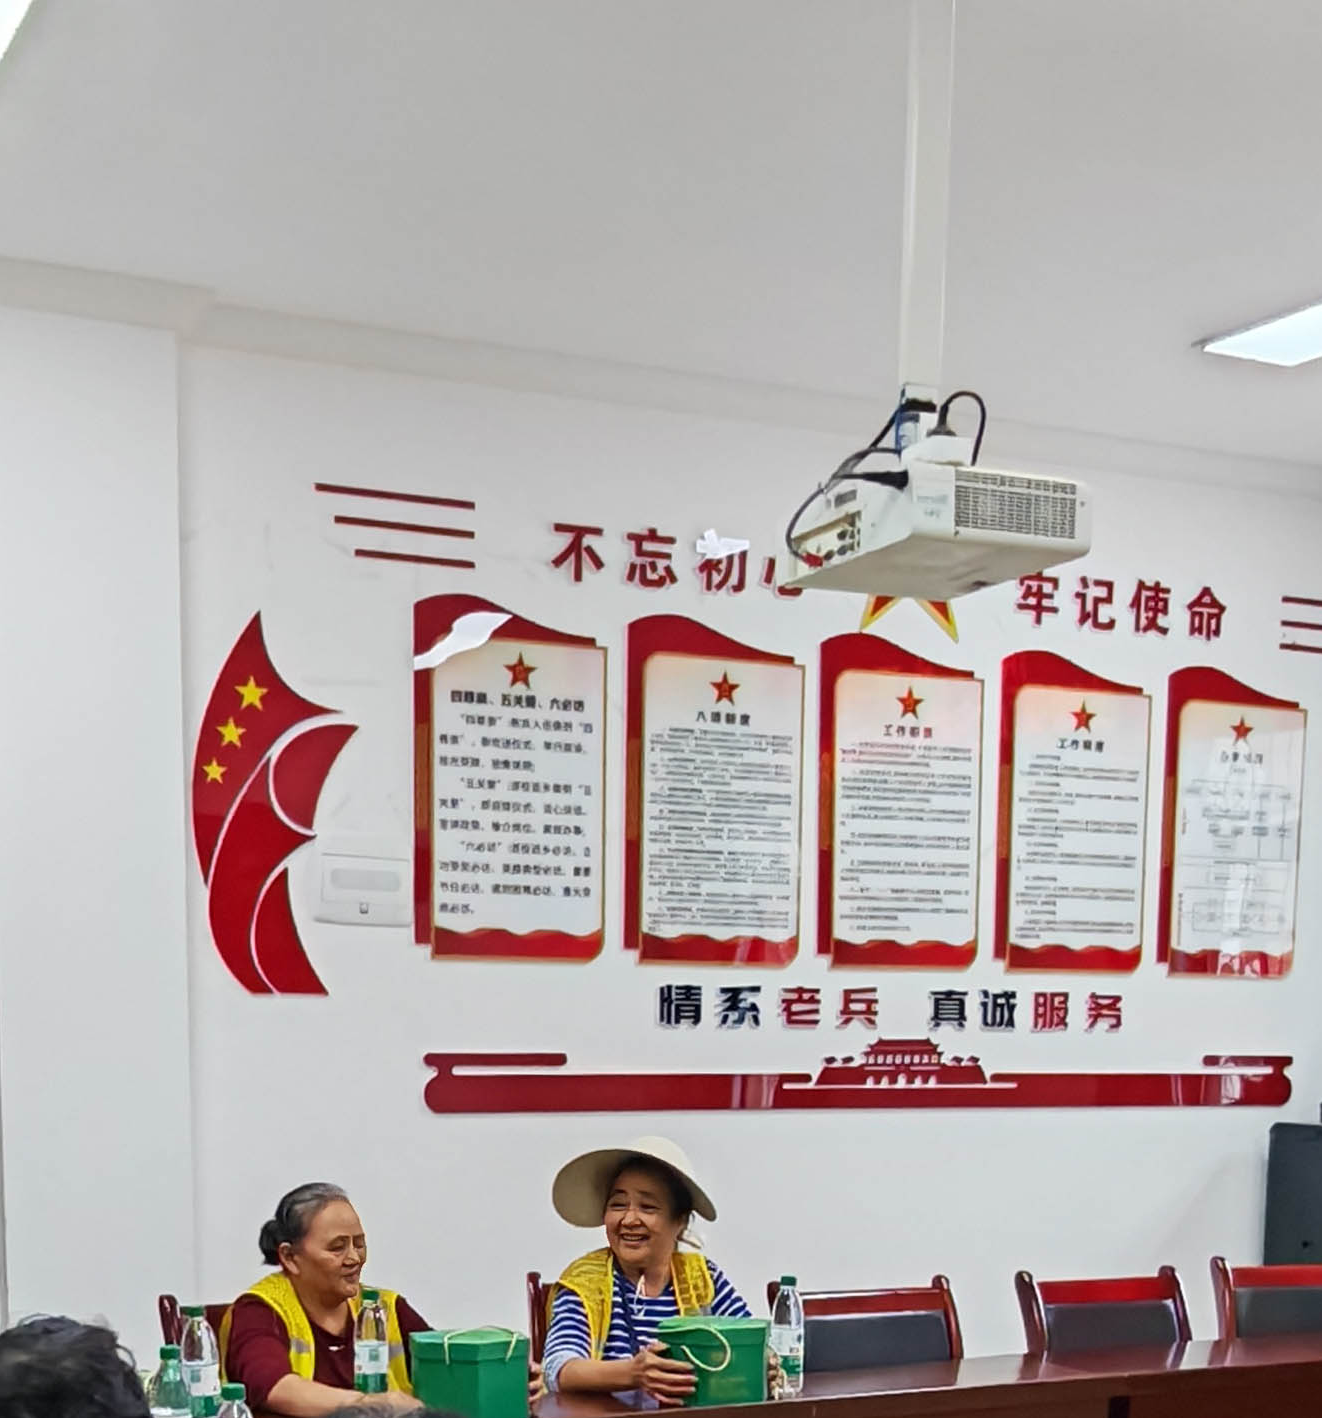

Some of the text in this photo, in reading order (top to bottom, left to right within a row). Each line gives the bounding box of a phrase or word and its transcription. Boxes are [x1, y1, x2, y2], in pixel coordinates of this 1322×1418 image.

[1016, 571, 1227, 641] 牢记使命
[657, 984, 1124, 1033] 情系老兵 真诚服务
